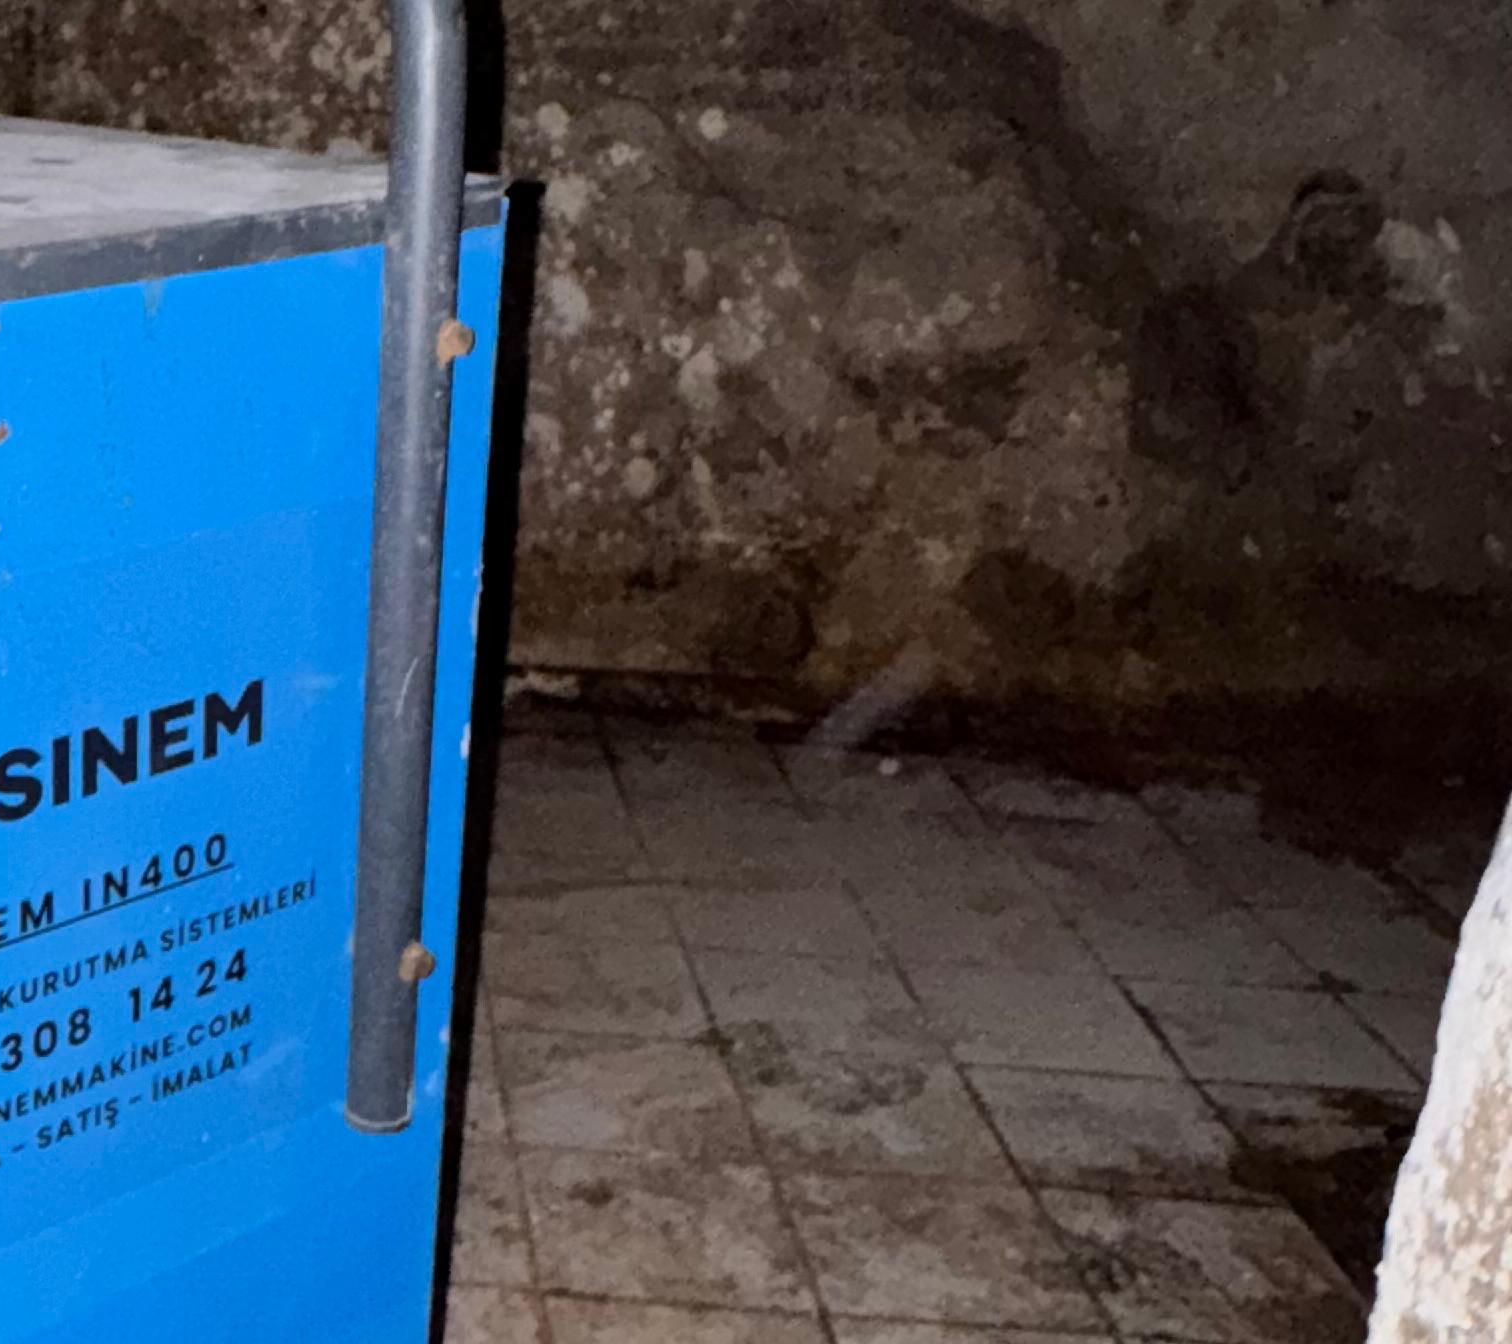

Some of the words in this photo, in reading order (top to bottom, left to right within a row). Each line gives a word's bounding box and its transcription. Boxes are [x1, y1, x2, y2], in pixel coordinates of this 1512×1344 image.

[82, 833, 228, 912] IN400
[160, 867, 316, 953] SİSTEMLERİ
[0, 1007, 93, 1073] 308
[128, 975, 175, 1023] 14
[195, 947, 247, 998] 24
[35, 1098, 119, 1150] SATIŞ
[151, 1041, 253, 1102] İMALAT
